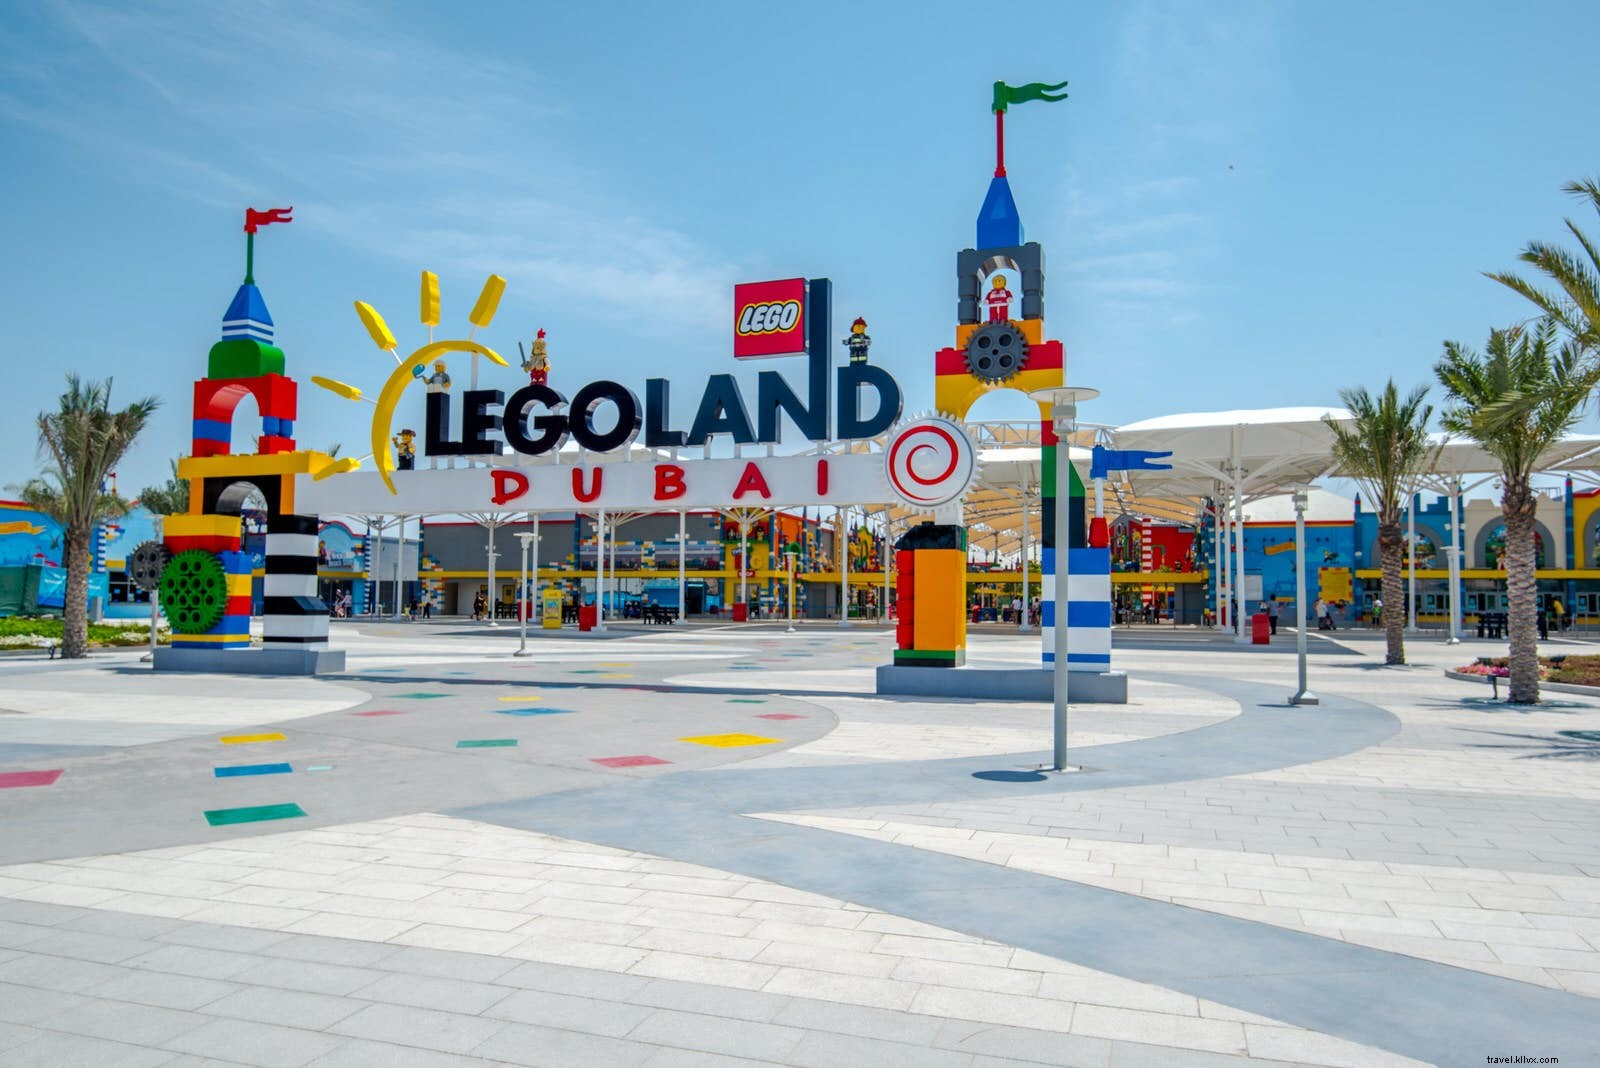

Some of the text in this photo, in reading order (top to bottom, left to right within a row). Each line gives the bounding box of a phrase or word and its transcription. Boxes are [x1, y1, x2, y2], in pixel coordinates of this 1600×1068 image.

[738, 301, 800, 334] LEGO
[425, 278, 904, 456] LEGOLAND
[490, 459, 828, 505] DUBAI
